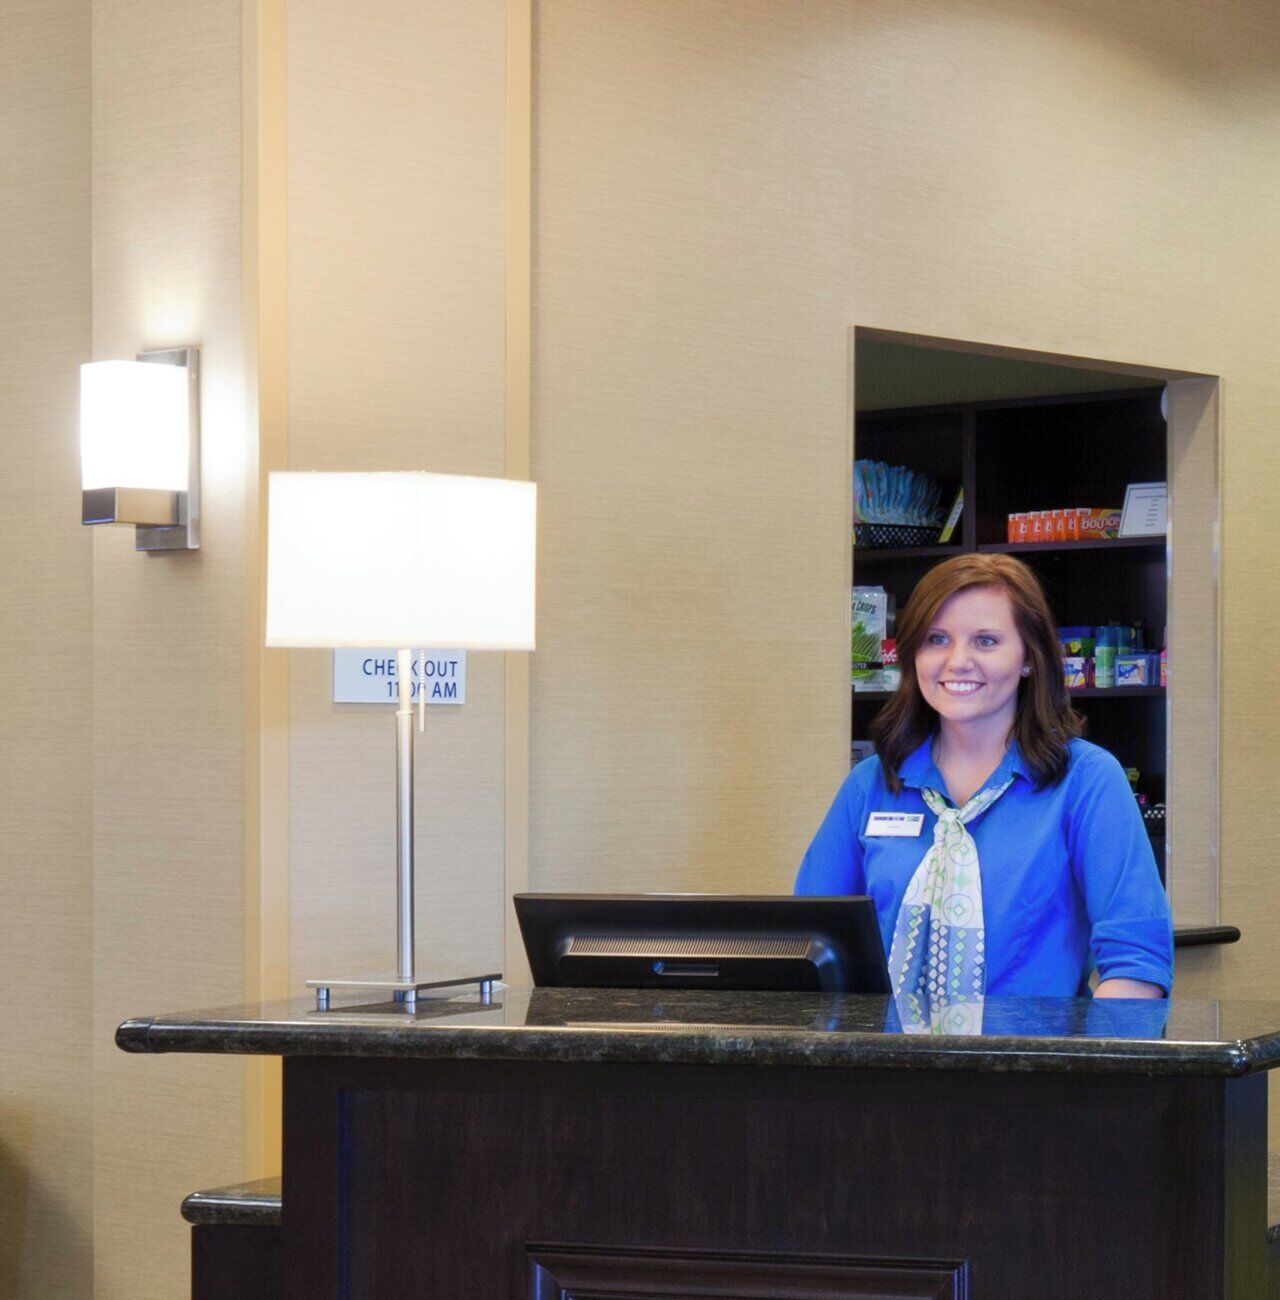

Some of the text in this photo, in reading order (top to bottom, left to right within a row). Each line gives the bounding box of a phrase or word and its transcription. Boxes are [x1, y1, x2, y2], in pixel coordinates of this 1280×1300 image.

[362, 658, 458, 678] CHEK OUT
[432, 681, 458, 699] AM
